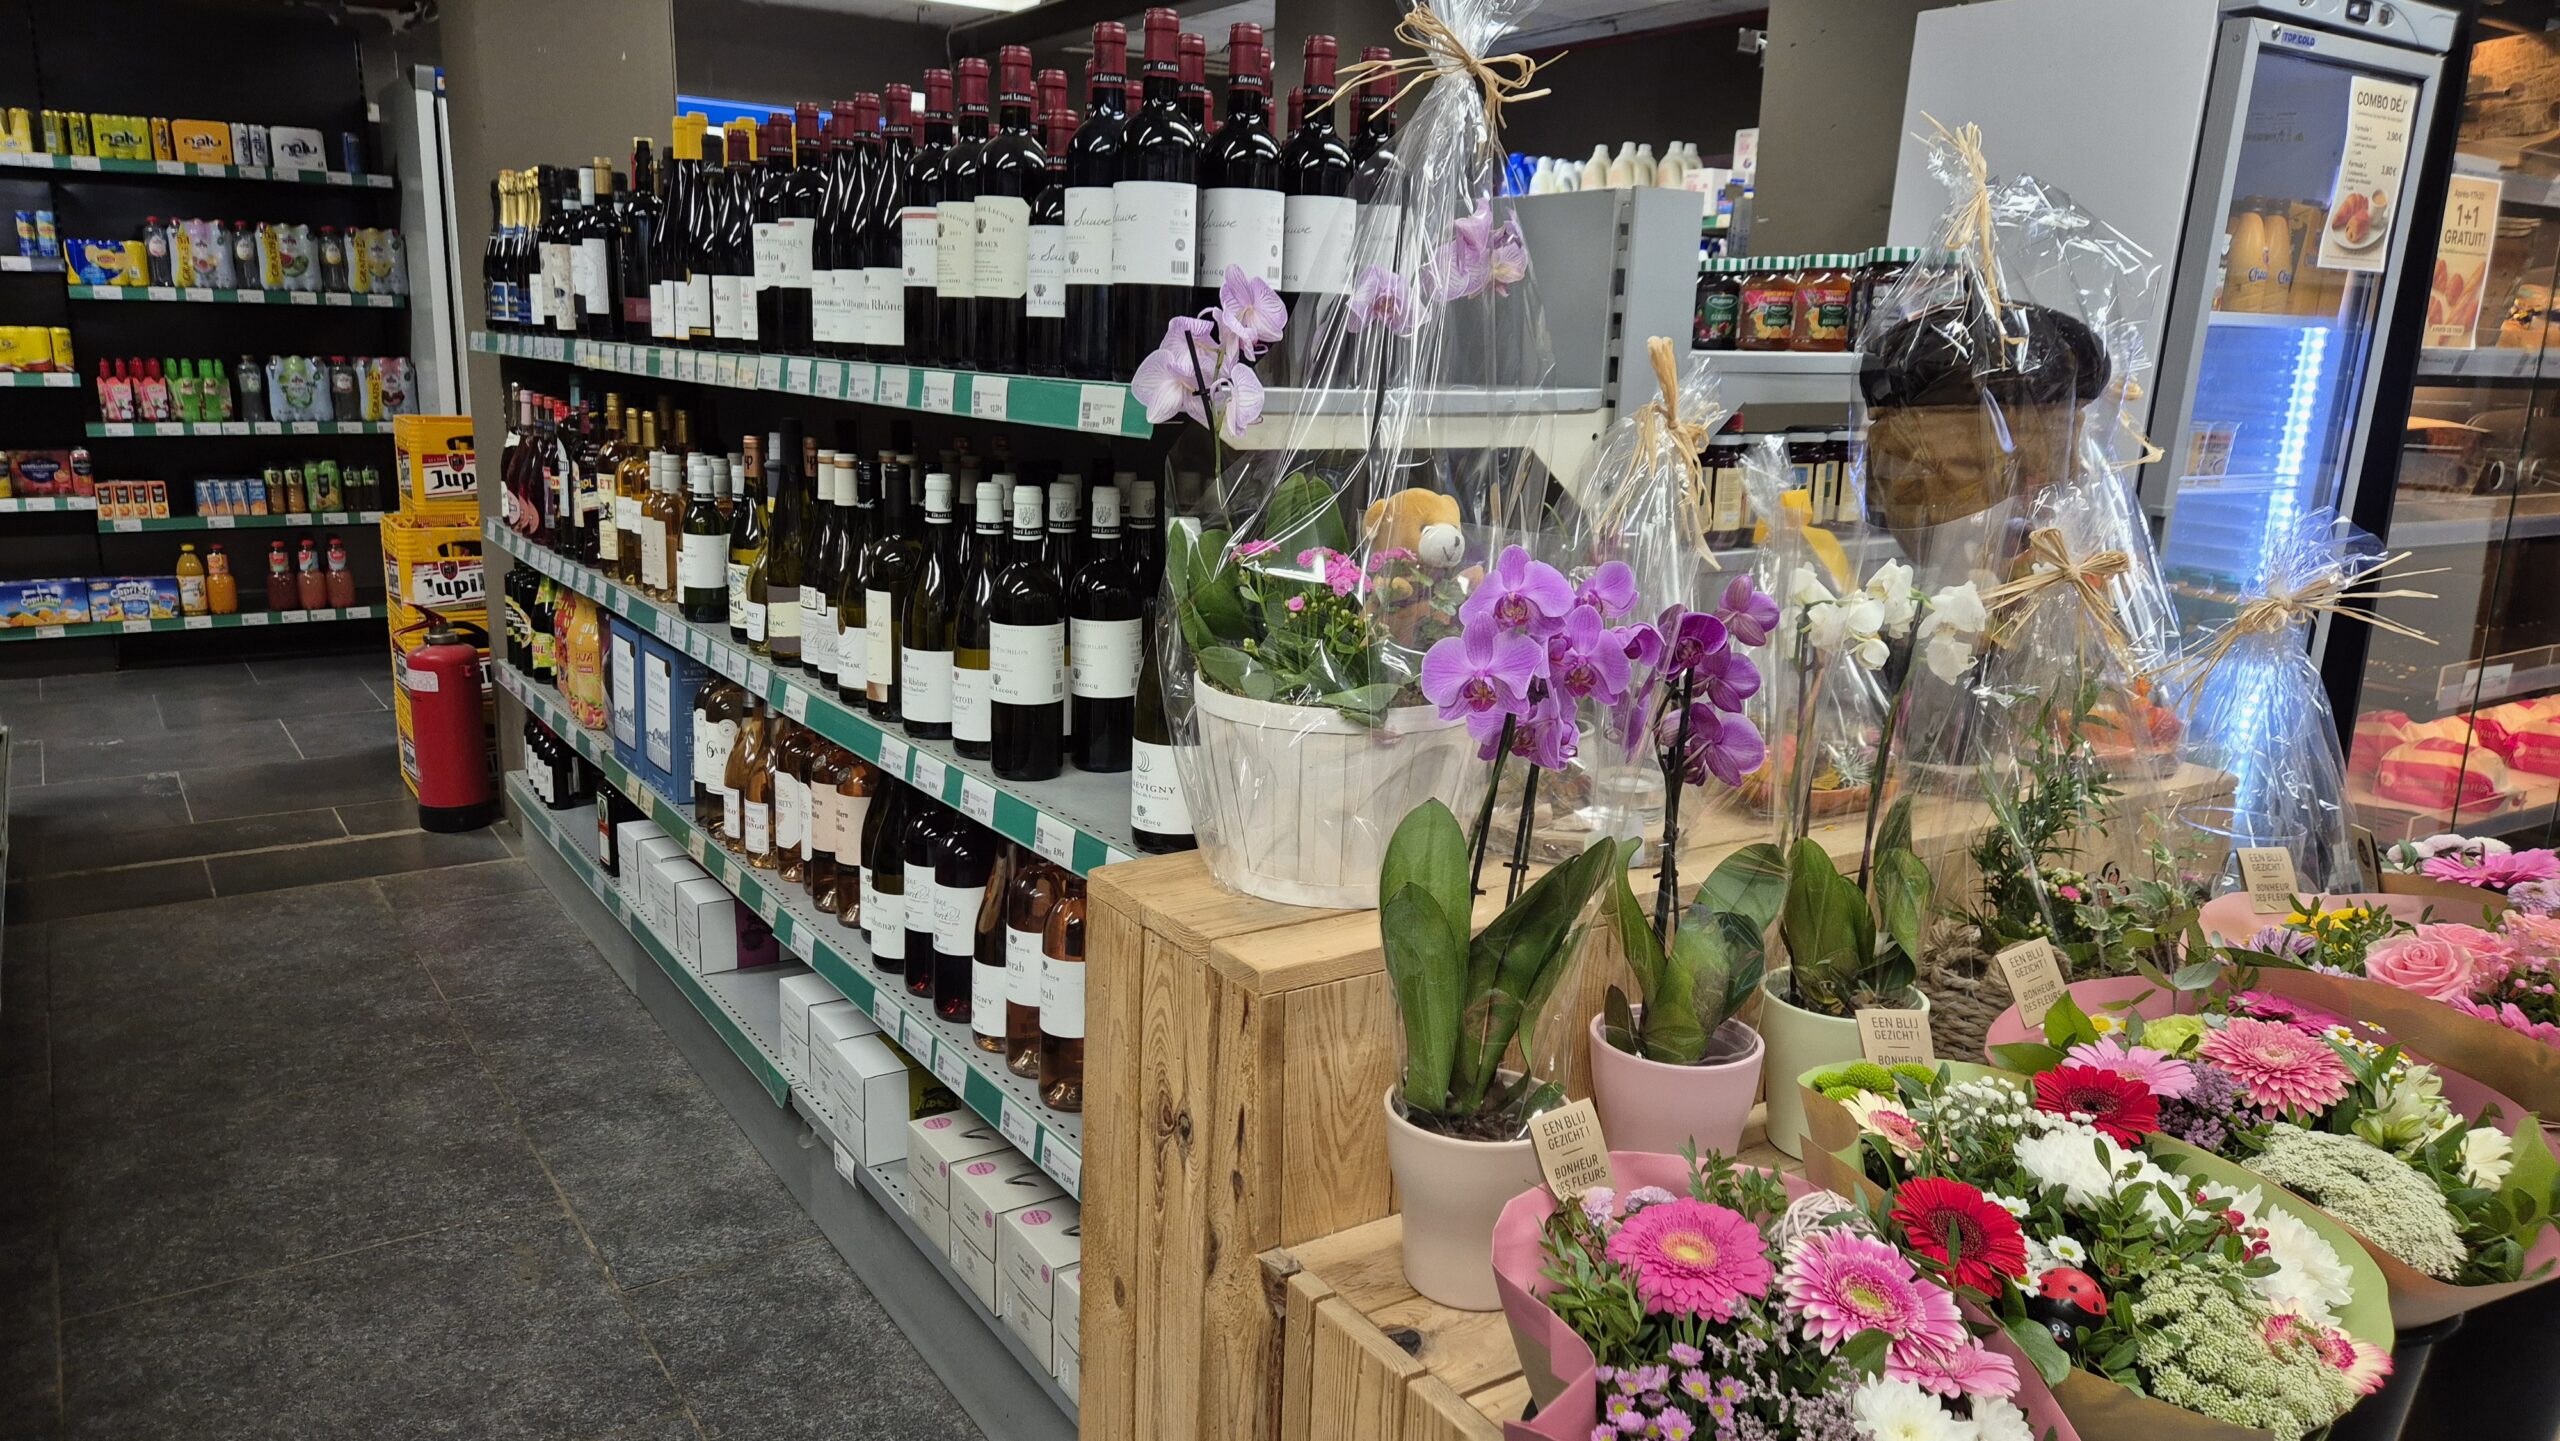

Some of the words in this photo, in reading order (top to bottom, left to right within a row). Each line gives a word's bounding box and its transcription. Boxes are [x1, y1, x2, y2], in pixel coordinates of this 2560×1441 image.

[2283, 32, 2298, 45] TOP
[2356, 91, 2389, 110] COMBO
[2456, 203, 2480, 228] 1+1
[2444, 229, 2486, 248] GRATUIT!
[2248, 853, 2265, 863] EEN
[2252, 863, 2280, 872] GEZICHT
[2256, 882, 2290, 892] BONHEUR
[2267, 893, 2290, 902] FLEUR
[2008, 954, 2027, 969] EEN
[2025, 946, 2045, 962] BLIJ
[2014, 959, 2045, 979] GEZICHT
[2022, 980, 2057, 1001] BONHEUR
[2023, 1002, 2037, 1013] DES
[1871, 1017, 1893, 1029] EEN
[1896, 1017, 1919, 1029] BLIJ
[1874, 1030, 1914, 1040] GEZICHT
[1542, 1119, 1563, 1137] EEN
[1563, 1110, 1587, 1129] BLIJ
[1547, 1127, 1586, 1151] GEZICHT
[1554, 1153, 1599, 1180] BONHEUR
[1556, 1179, 1571, 1195] DES
[1572, 1166, 1607, 1188] FLEURS
